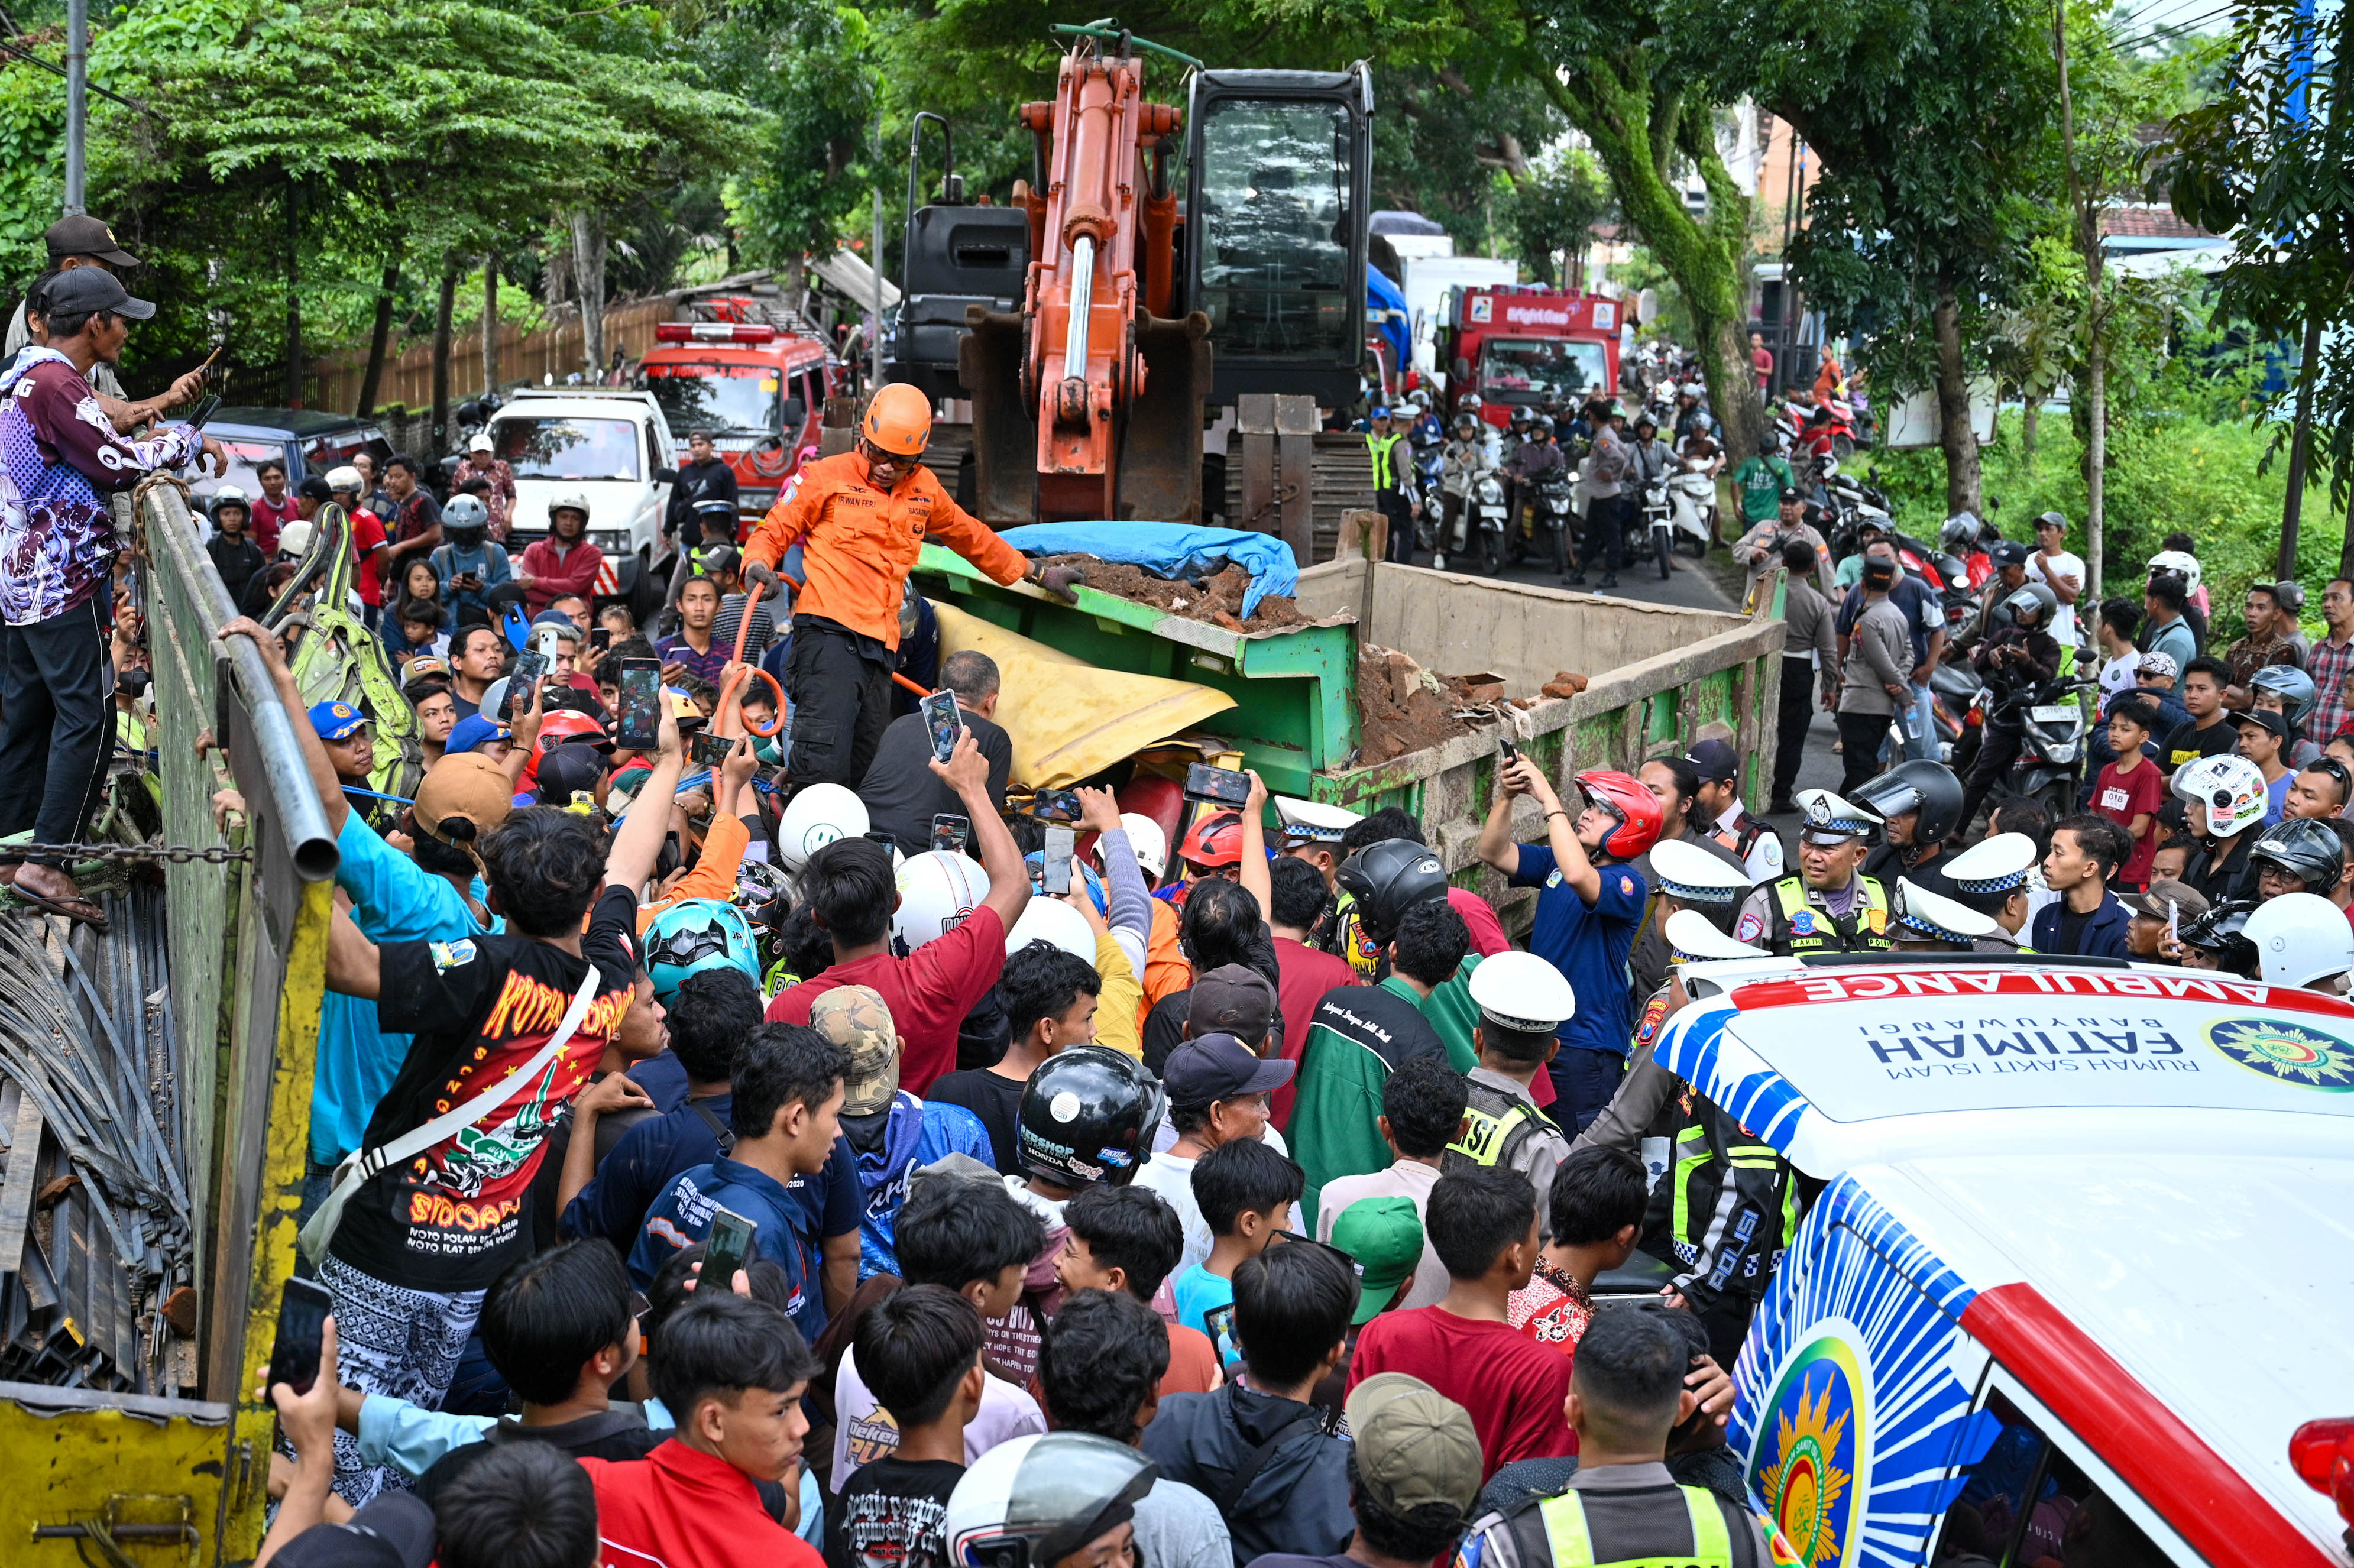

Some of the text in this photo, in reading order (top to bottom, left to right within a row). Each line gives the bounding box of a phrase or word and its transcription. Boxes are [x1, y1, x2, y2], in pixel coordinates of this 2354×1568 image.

[838, 495, 876, 508] IRWAN FERI
[1793, 939, 1822, 947] FAKIH
[1795, 971, 2269, 1004] AMBULANCE
[1860, 1018, 2164, 1035] BANYUWANGI
[1868, 1031, 2184, 1064] FATIMAH
[1886, 1059, 2200, 1080] RUMAH SAKIT ISLAM
[1021, 1123, 1074, 1155] REDSHOP
[1028, 1146, 1064, 1167] HONDA
[1068, 1159, 1103, 1177] wondr
[410, 1227, 440, 1242] NOTO
[407, 1237, 439, 1253] NOTO
[1708, 1207, 1759, 1292] POLISI
[993, 1343, 1011, 1353] HOPE
[1777, 1449, 1796, 1494] RUMAH
[1810, 1478, 1824, 1544] FATIMAH
